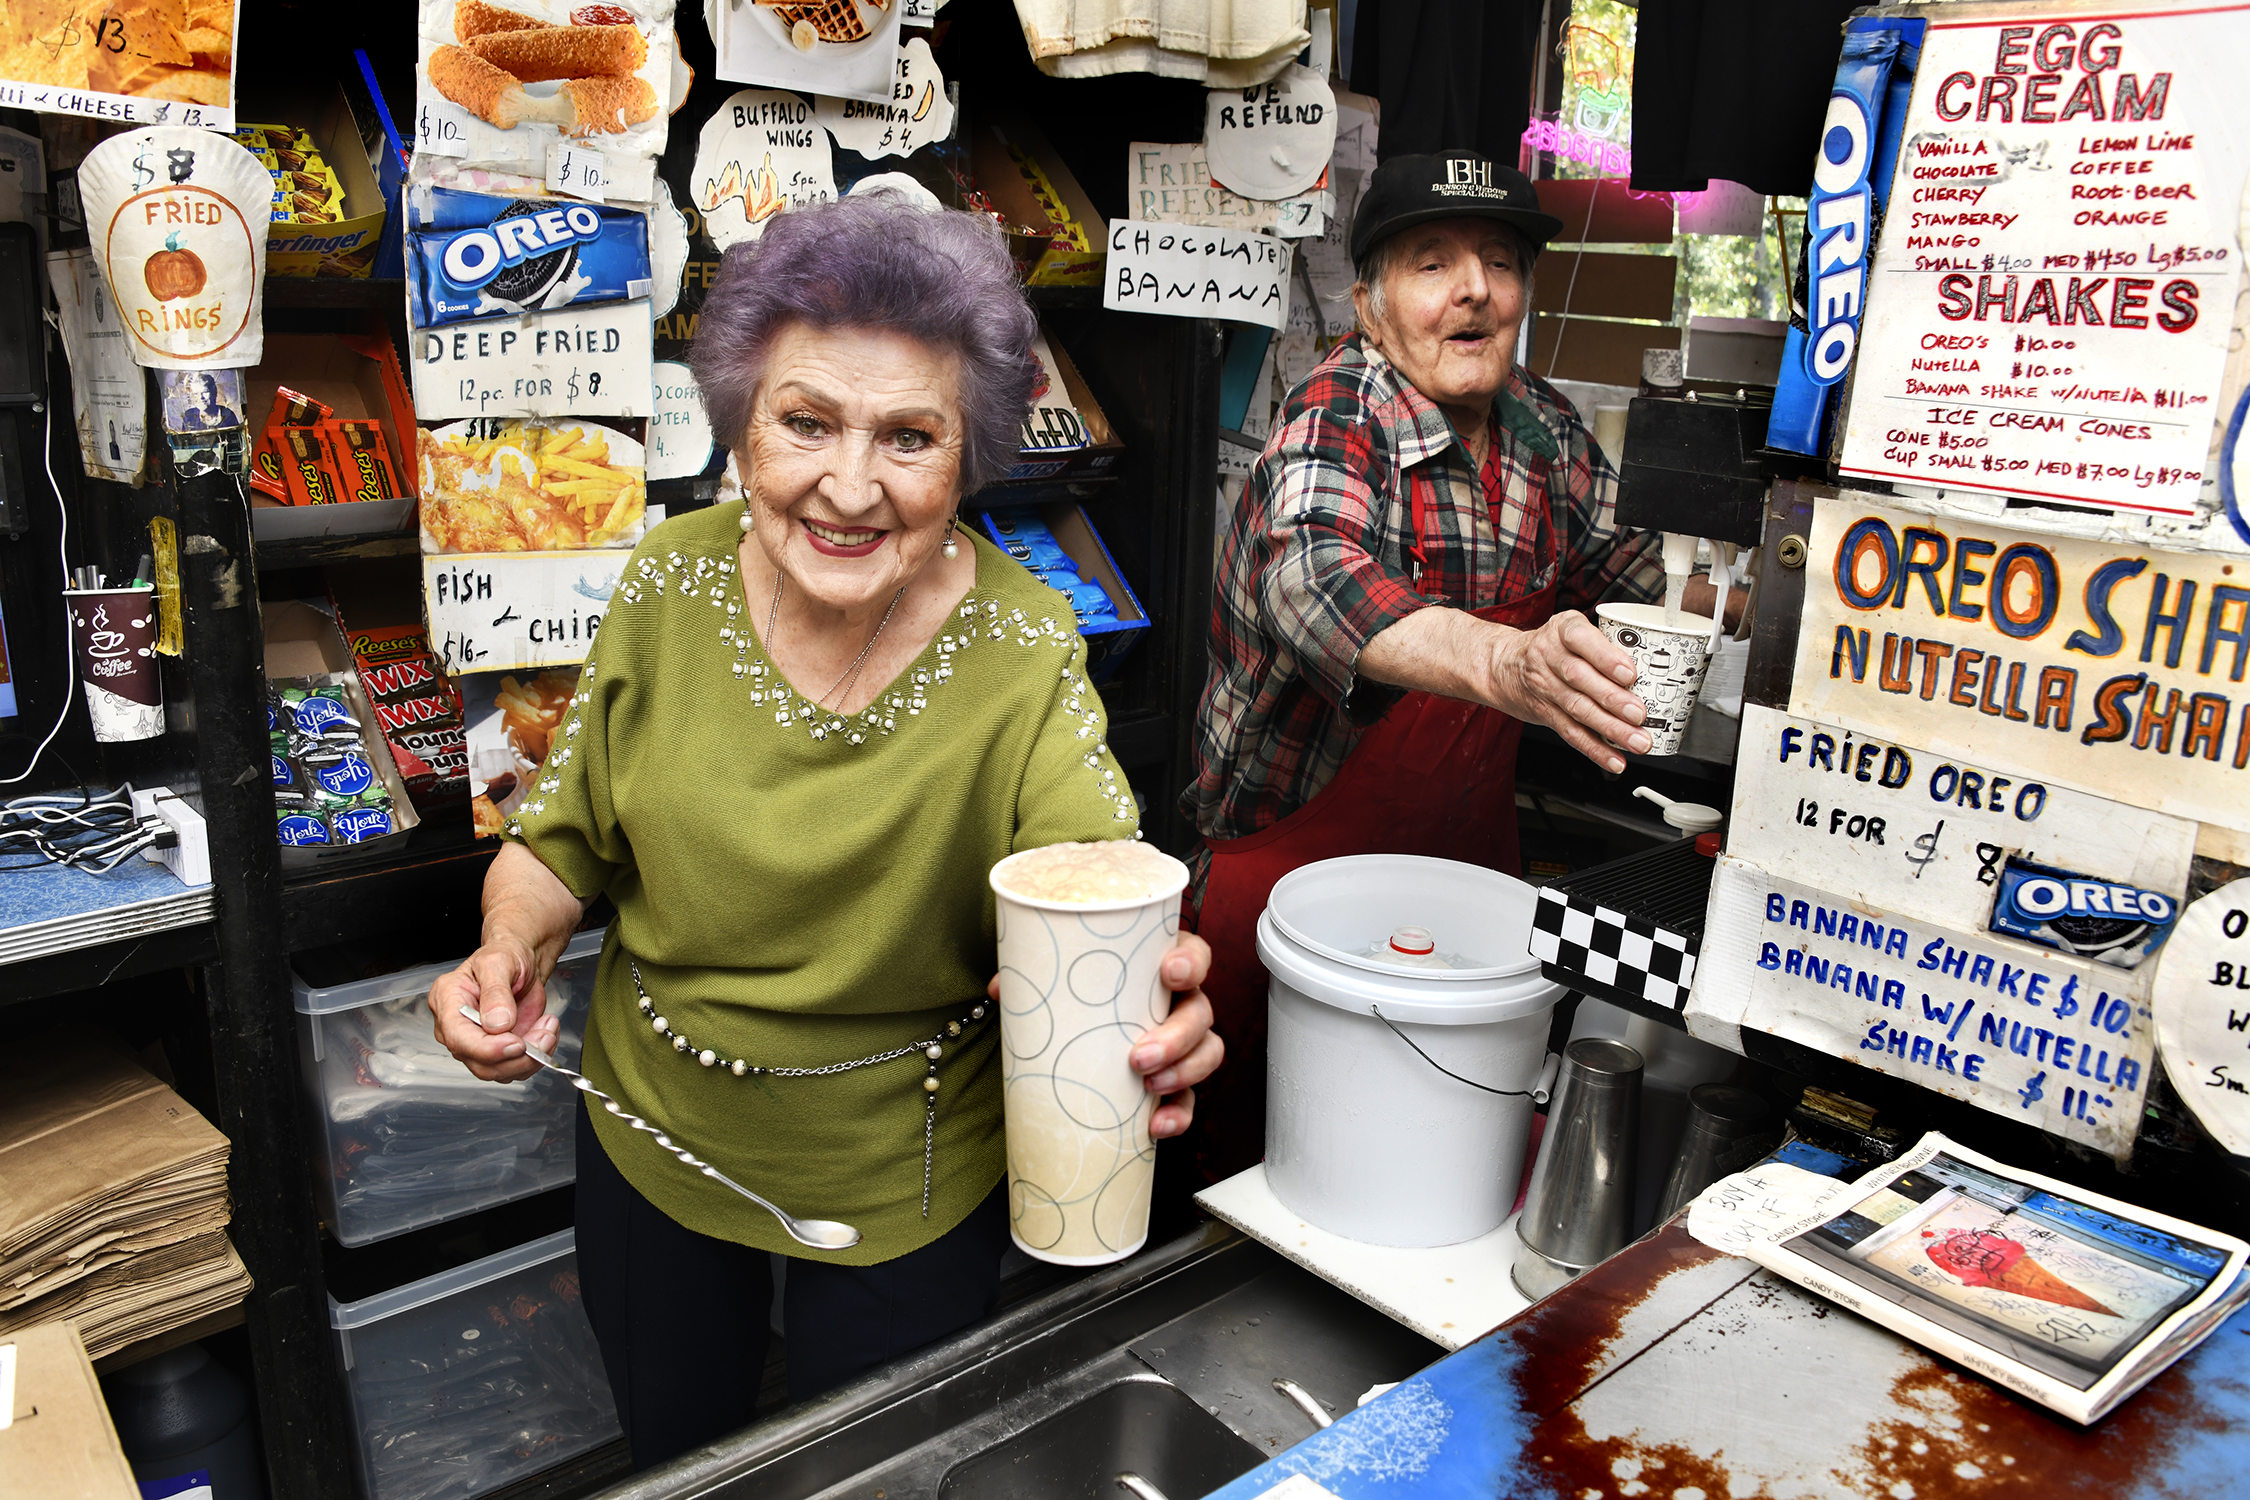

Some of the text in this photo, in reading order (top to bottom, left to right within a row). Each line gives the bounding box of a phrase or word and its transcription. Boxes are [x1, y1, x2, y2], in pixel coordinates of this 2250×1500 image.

[37, 6, 81, 60] $
[1994, 23, 2123, 76] EGG
[57, 93, 136, 121] CHEESE
[153, 102, 171, 123] $
[1243, 83, 1281, 105] WE
[1935, 71, 2173, 123] CREAM
[419, 104, 430, 145] $
[732, 101, 807, 129] BUFFALO
[843, 100, 909, 125] BANANA
[1220, 103, 1324, 129] REFUND
[766, 129, 813, 148] WINGS
[877, 126, 893, 151] $
[2079, 135, 2139, 154] LEMON
[131, 143, 155, 195] $
[557, 150, 571, 186] $
[1137, 151, 1210, 187] FRIE
[1912, 162, 1998, 181] CHOCOLATE
[2070, 160, 2154, 176] COFFEE
[1912, 186, 1987, 206] CHERRY
[1281, 201, 1295, 221] $
[1297, 203, 1313, 226] 7
[1911, 212, 2019, 231] STAWBERRY
[2073, 210, 2169, 227] ORANGE
[443, 206, 600, 283] OREO
[1814, 95, 1868, 380] OREO
[1907, 236, 1981, 250] MANGO
[1915, 256, 1977, 272] SMALL
[2043, 254, 2080, 270] MED
[1118, 267, 1282, 312] BANANA
[1938, 273, 2200, 334] SHAKES
[436, 301, 469, 313] 6 COOKIES
[425, 328, 517, 365] DEEP
[2013, 333, 2077, 354] $10.00
[514, 378, 552, 398] FOR
[566, 366, 580, 409] $
[2010, 361, 2074, 380] $10.00
[1905, 379, 1970, 396] BANANA
[1981, 384, 2039, 400] SHAKE
[666, 410, 691, 426] TEA
[1926, 407, 2153, 440] ICE CREAM CONES
[1886, 429, 1989, 450] CONE $5.00
[1928, 453, 1976, 470] SMALL
[1981, 454, 2029, 473] $5.00
[2034, 459, 2072, 477] MED
[1832, 515, 2062, 642] OREO
[352, 634, 418, 656] Reese's
[92, 658, 133, 678] Coffee
[1829, 623, 2080, 733] NUTELLA
[297, 701, 340, 740] York
[323, 751, 371, 792] York
[1928, 761, 2049, 823] OREO
[279, 820, 324, 845] York
[338, 811, 386, 845] York
[1795, 797, 1819, 829] 12
[1828, 807, 1888, 846] FOR
[2015, 874, 2173, 923] OREO
[1765, 891, 1909, 961] BANANA
[1916, 935, 2053, 1009] SHAKE
[2052, 973, 2080, 1021] $
[1757, 940, 1906, 1011] BANANA
[1978, 1010, 2143, 1093] NUTELLA
[1858, 1018, 1986, 1083] SHAKE
[2016, 1069, 2047, 1111] $
[1864, 1144, 1937, 1190] WHITNEY BROWNE
[1709, 1176, 1768, 1213] BUY A
[1766, 1210, 1831, 1243] CANDY STORE
[1802, 1275, 1863, 1311] CANDY STORE
[1961, 1352, 2050, 1402] WHITNEY BROWNE
